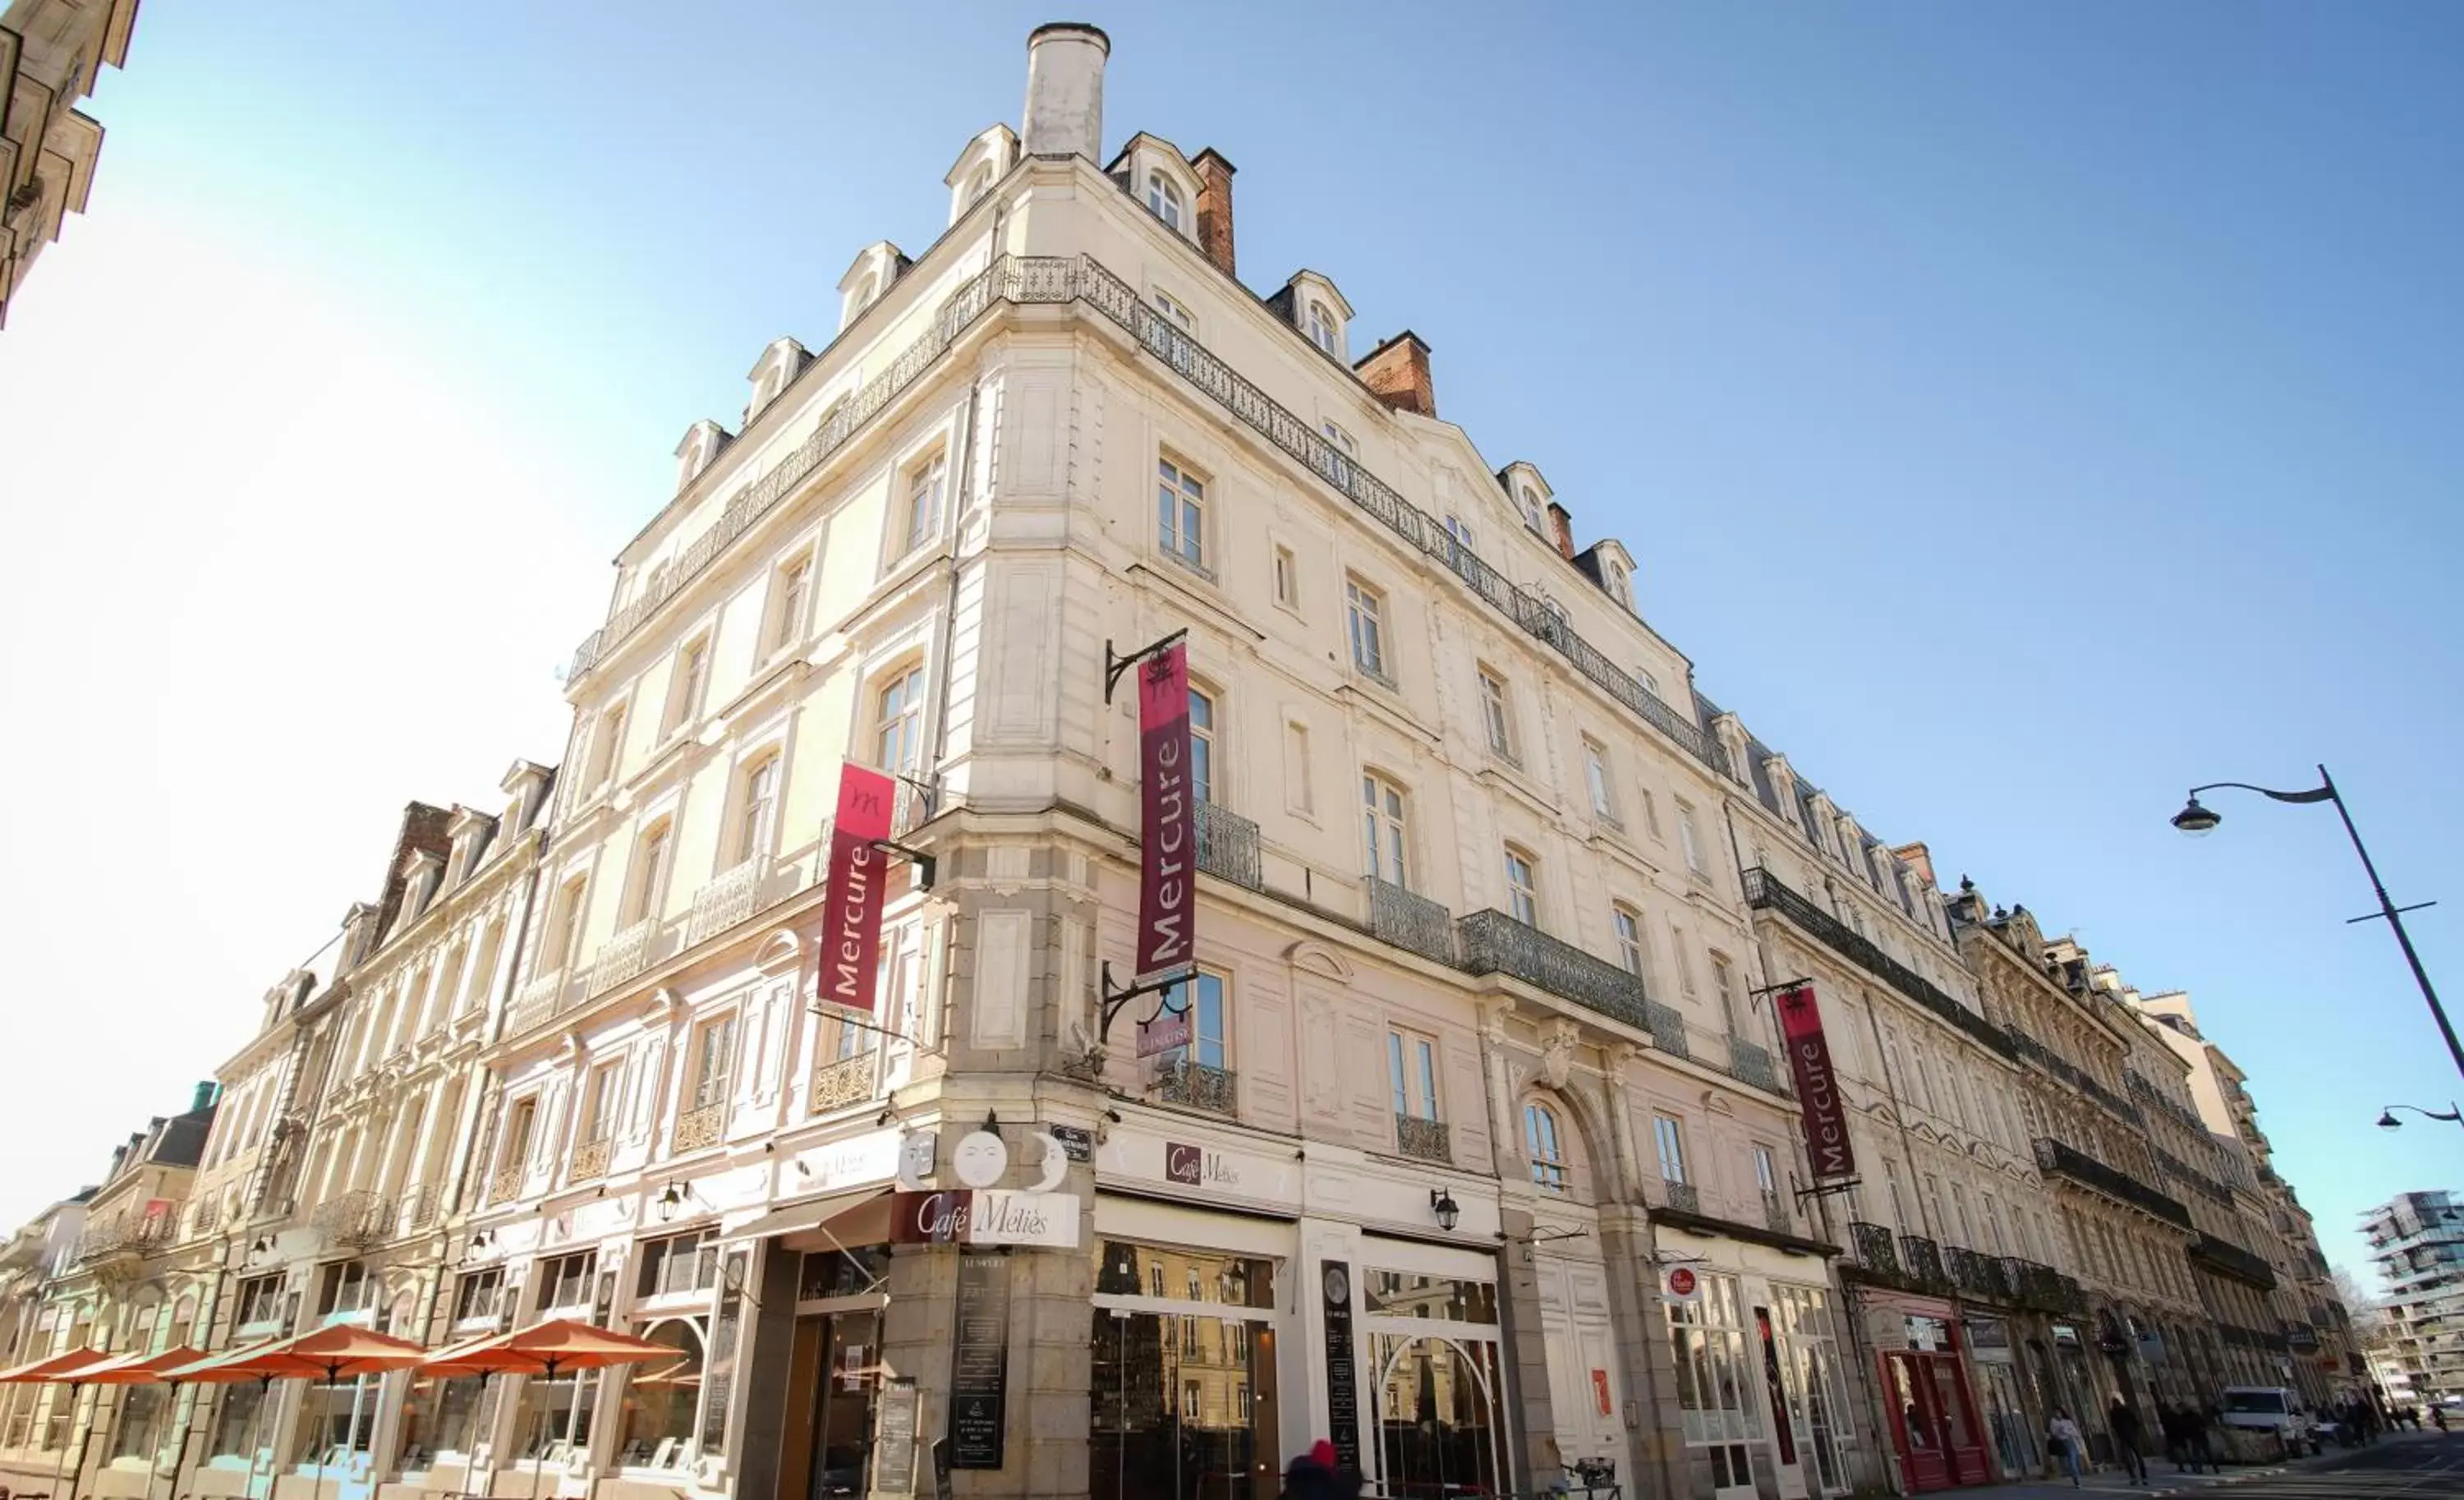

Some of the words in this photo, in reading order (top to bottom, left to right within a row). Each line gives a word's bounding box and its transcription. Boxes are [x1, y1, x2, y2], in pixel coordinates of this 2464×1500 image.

[1152, 737, 1184, 963] Mercure
[835, 845, 871, 997] Mercure
[1801, 1042, 1846, 1173] Mercure
[917, 1193, 968, 1240] Café
[973, 1194, 1048, 1236] Méliès
